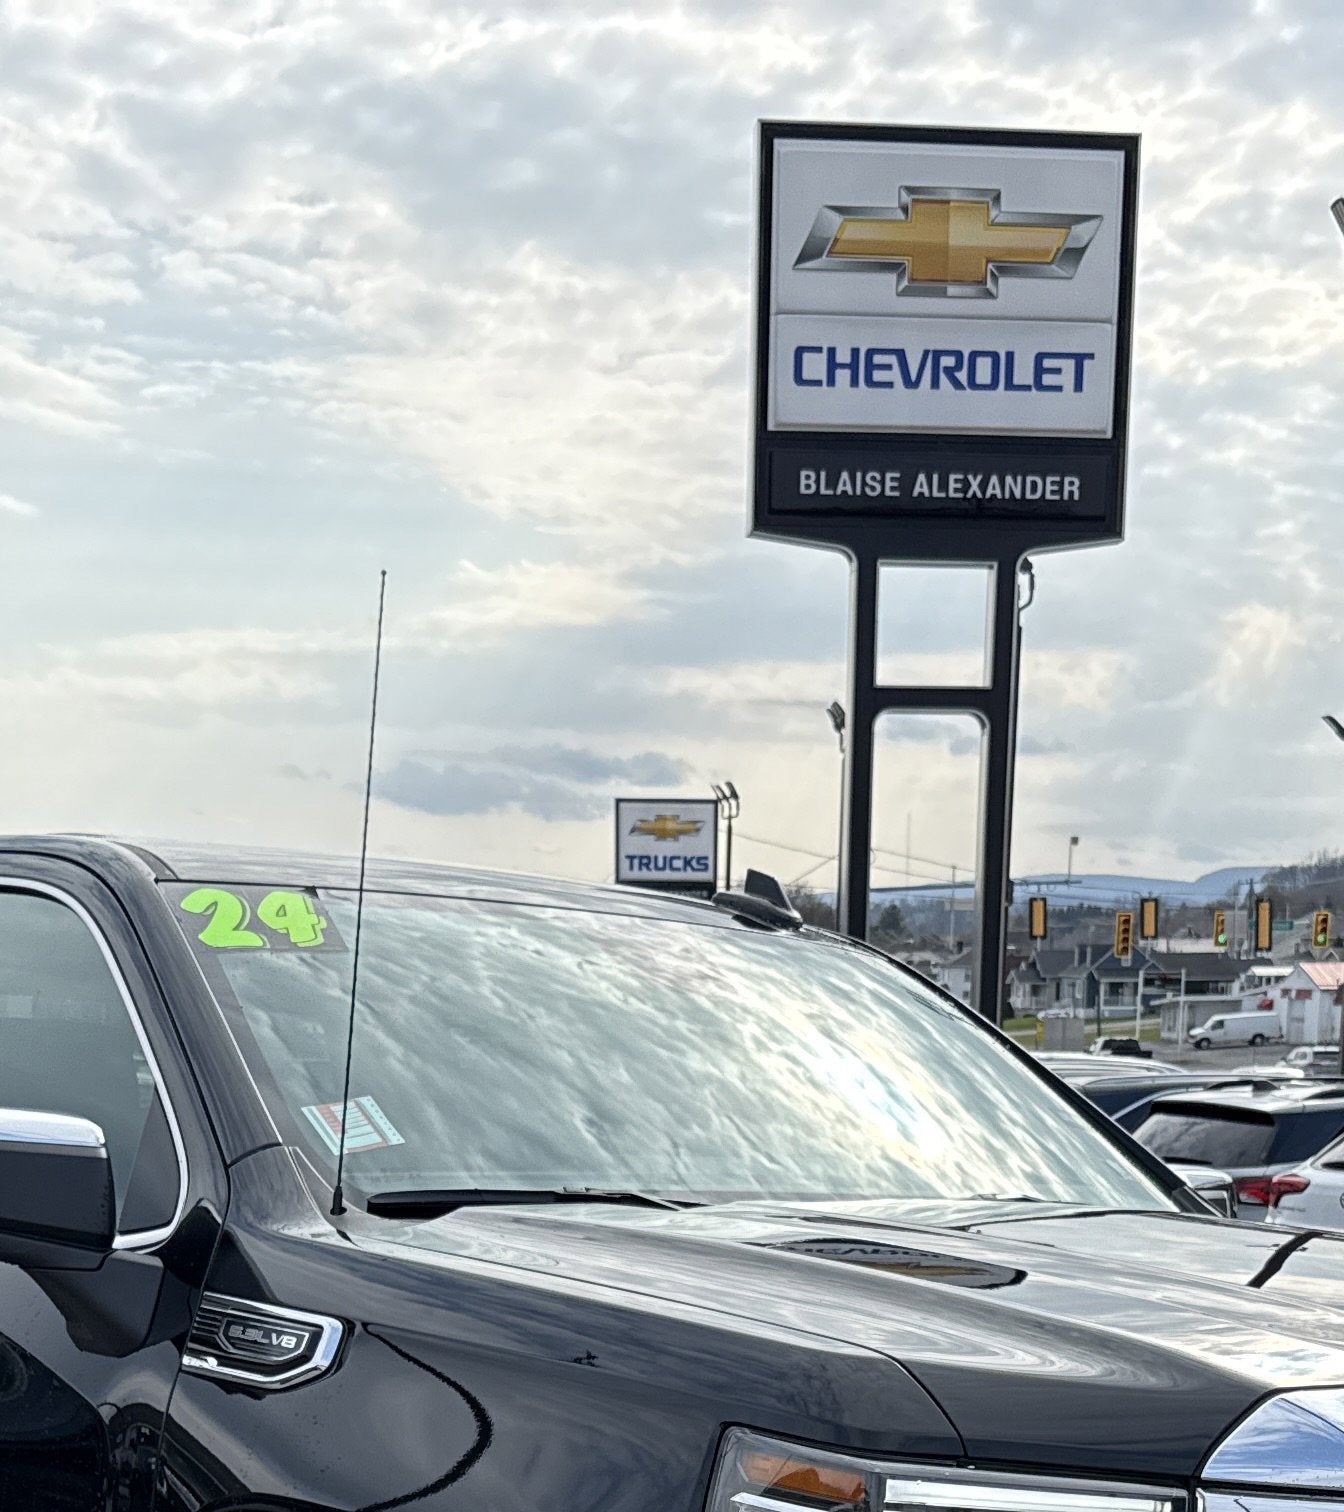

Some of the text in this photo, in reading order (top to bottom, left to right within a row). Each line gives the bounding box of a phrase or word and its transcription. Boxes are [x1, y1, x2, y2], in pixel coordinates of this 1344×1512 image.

[793, 346, 1095, 392] CHEVROLET
[799, 470, 1081, 500] BLAISE ALEXANDER
[625, 855, 709, 872] TRUCKS
[180, 888, 327, 948] 24
[271, 1332, 297, 1349] V8
